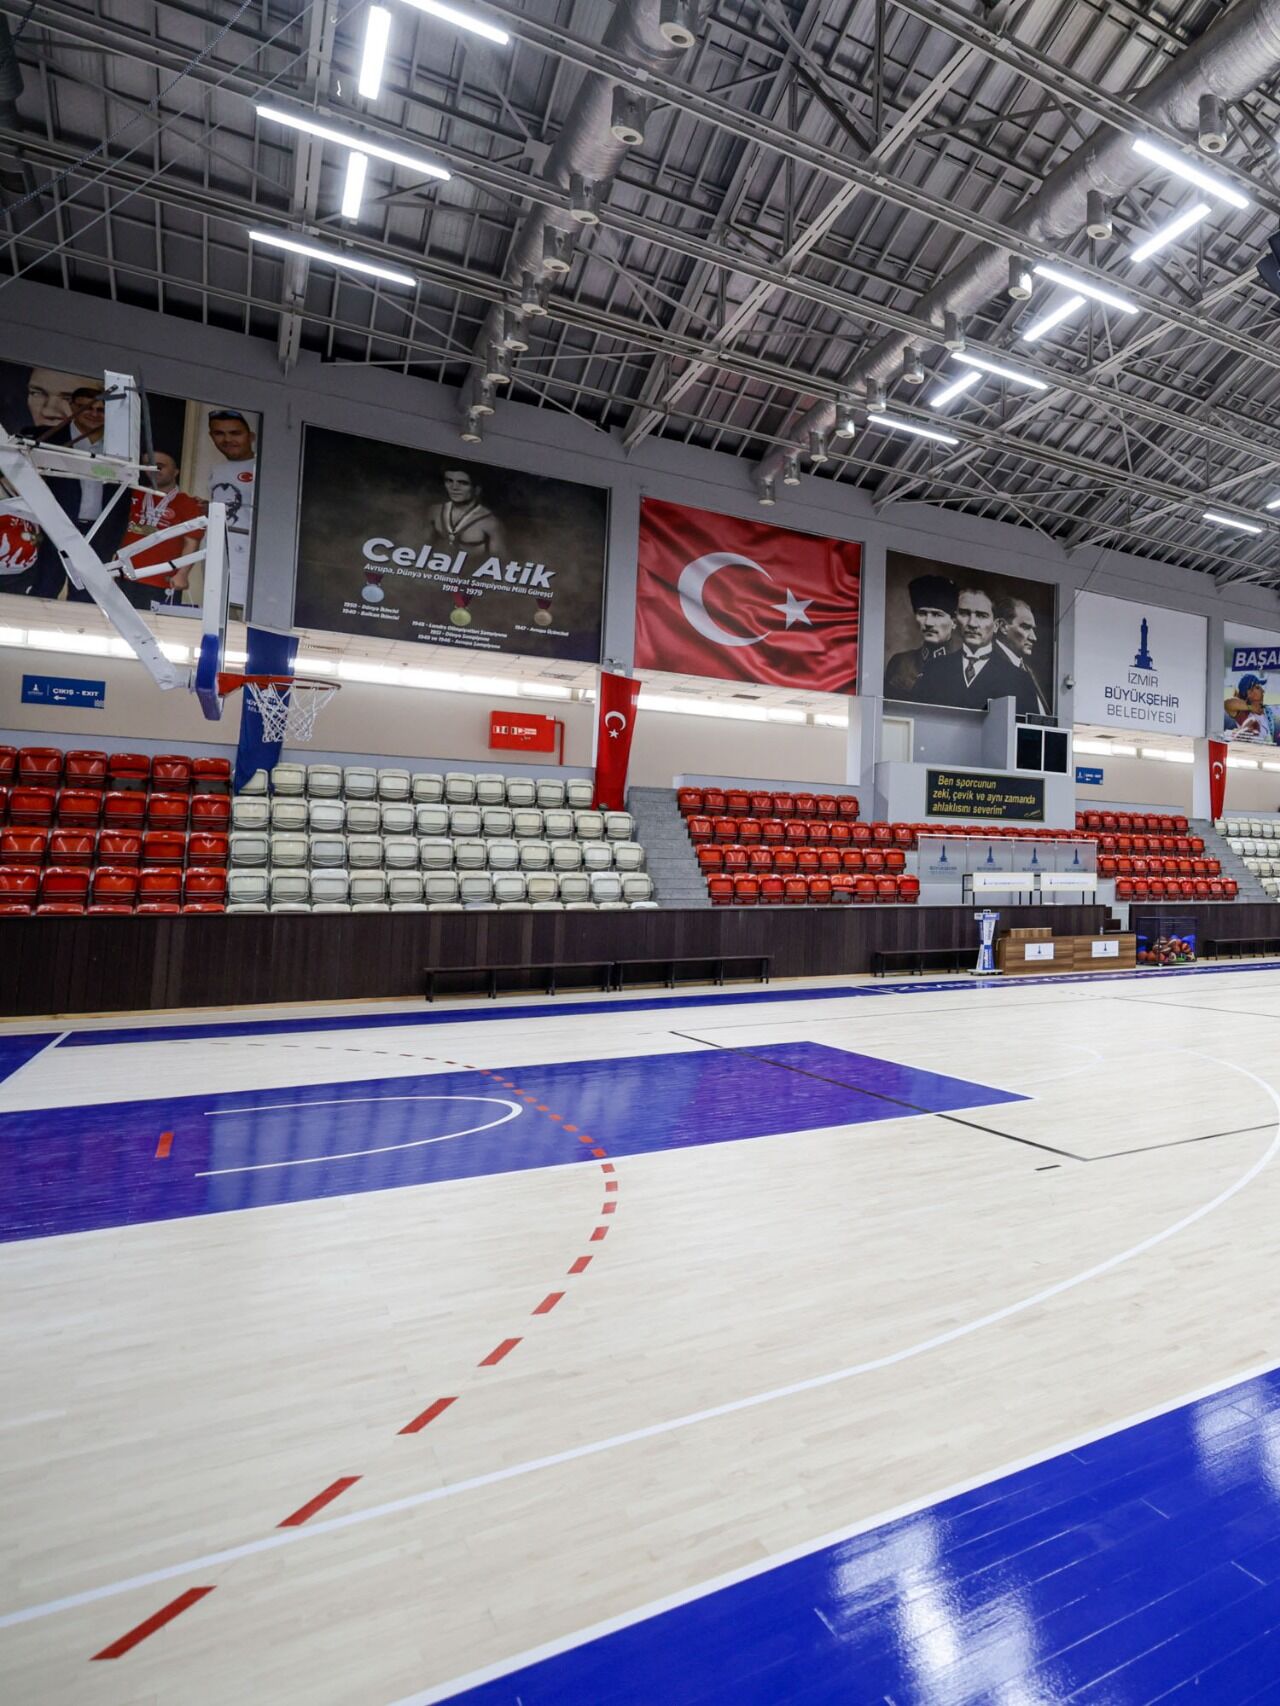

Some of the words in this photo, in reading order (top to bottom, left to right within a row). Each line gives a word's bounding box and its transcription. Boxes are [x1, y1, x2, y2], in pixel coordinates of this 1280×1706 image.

[362, 537, 468, 574] Celal
[472, 556, 555, 588] Atik
[363, 563, 395, 575] Avrupa,
[397, 567, 422, 578] Dünya
[434, 574, 469, 586] Olimpiyat
[470, 579, 510, 593] Şampiyonu
[511, 584, 526, 595] Milli
[528, 586, 554, 599] Güreşçi
[442, 584, 458, 593] 1918
[466, 588, 483, 597] 1979
[1127, 672, 1159, 688] İZMİR
[1104, 686, 1179, 708] BÜYÜKŞEHİR
[1106, 704, 1176, 724] BELEDİYESİ
[938, 775, 954, 785] Ben
[956, 780, 996, 789] sporcunun
[933, 789, 950, 800] zeki,
[953, 791, 974, 801] çevik
[987, 795, 1002, 804] aynı
[1004, 794, 1036, 805] zamanda
[932, 802, 970, 814] ahlaklısını
